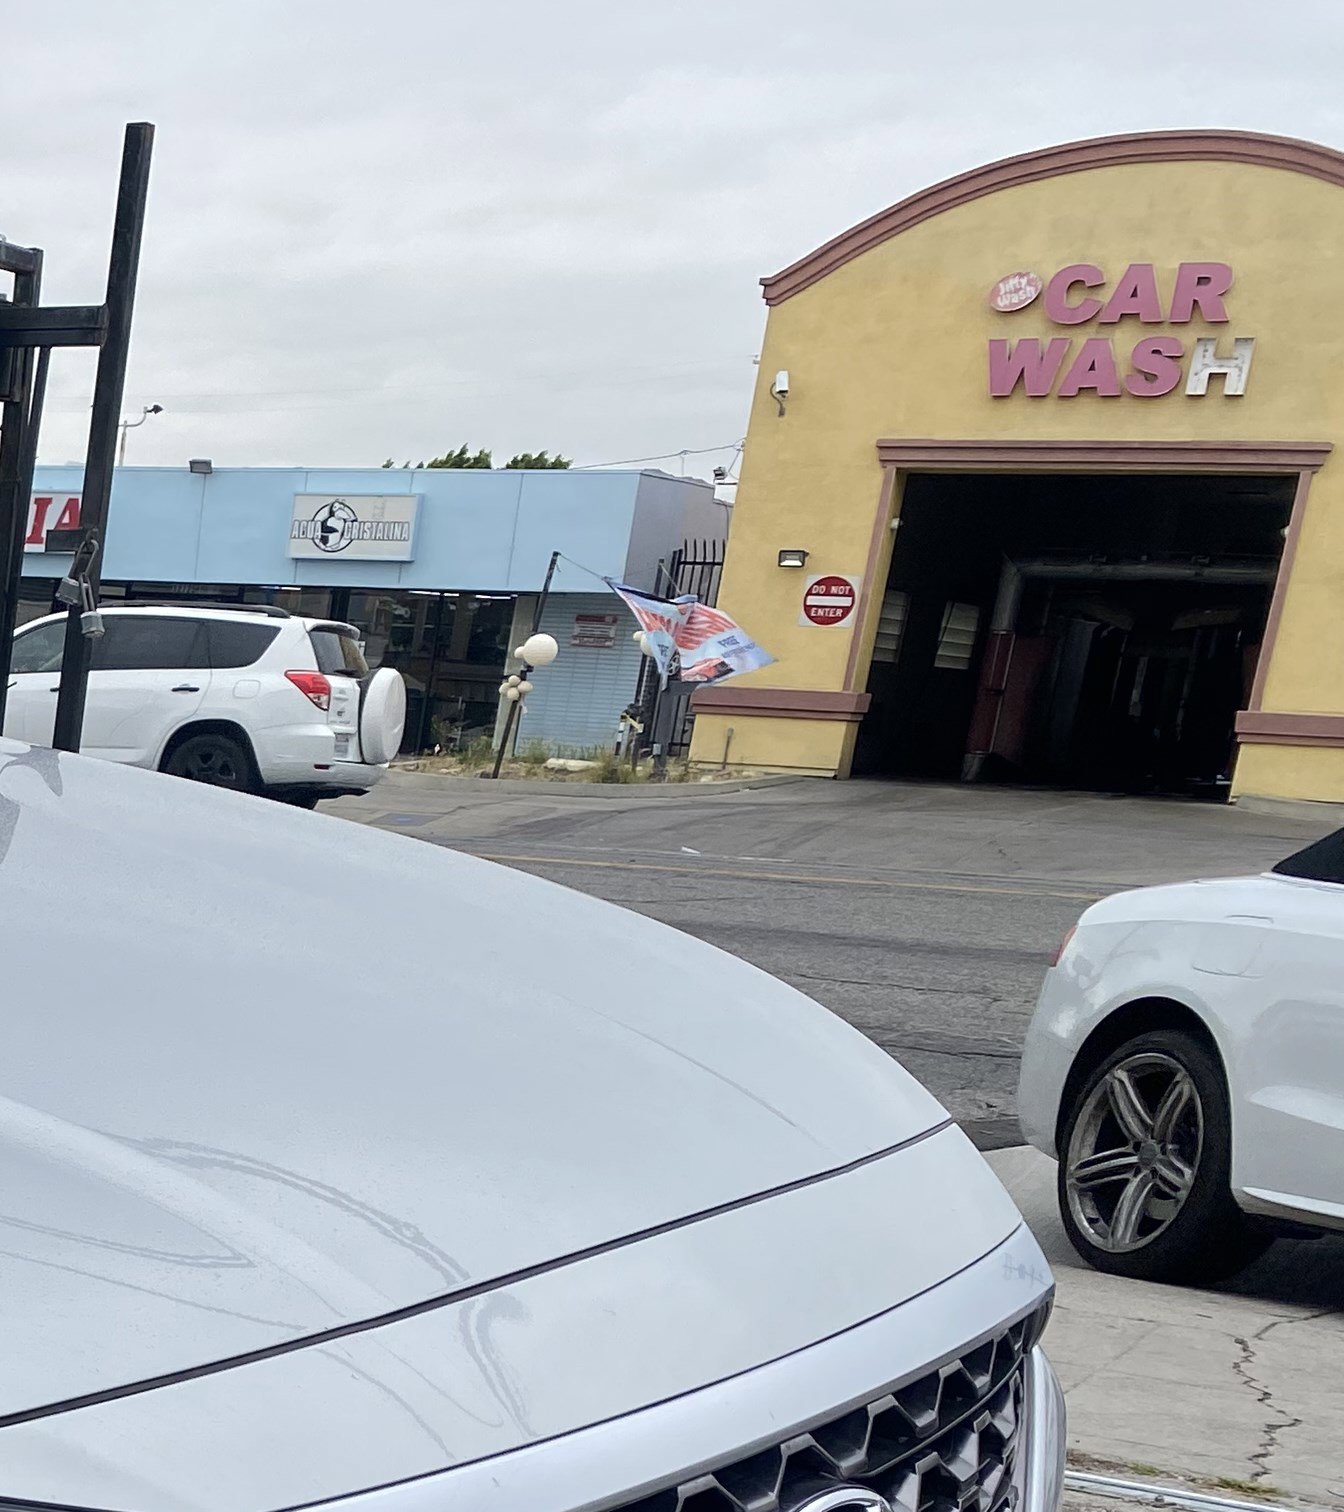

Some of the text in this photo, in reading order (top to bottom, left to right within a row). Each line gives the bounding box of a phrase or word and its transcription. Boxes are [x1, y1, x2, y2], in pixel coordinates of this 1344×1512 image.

[1044, 261, 1234, 324] CAR
[988, 336, 1256, 398] WASH
[290, 519, 410, 541] AGUA CRISTALINA
[812, 585, 851, 595] DO NOT
[811, 608, 843, 617] ENTER
